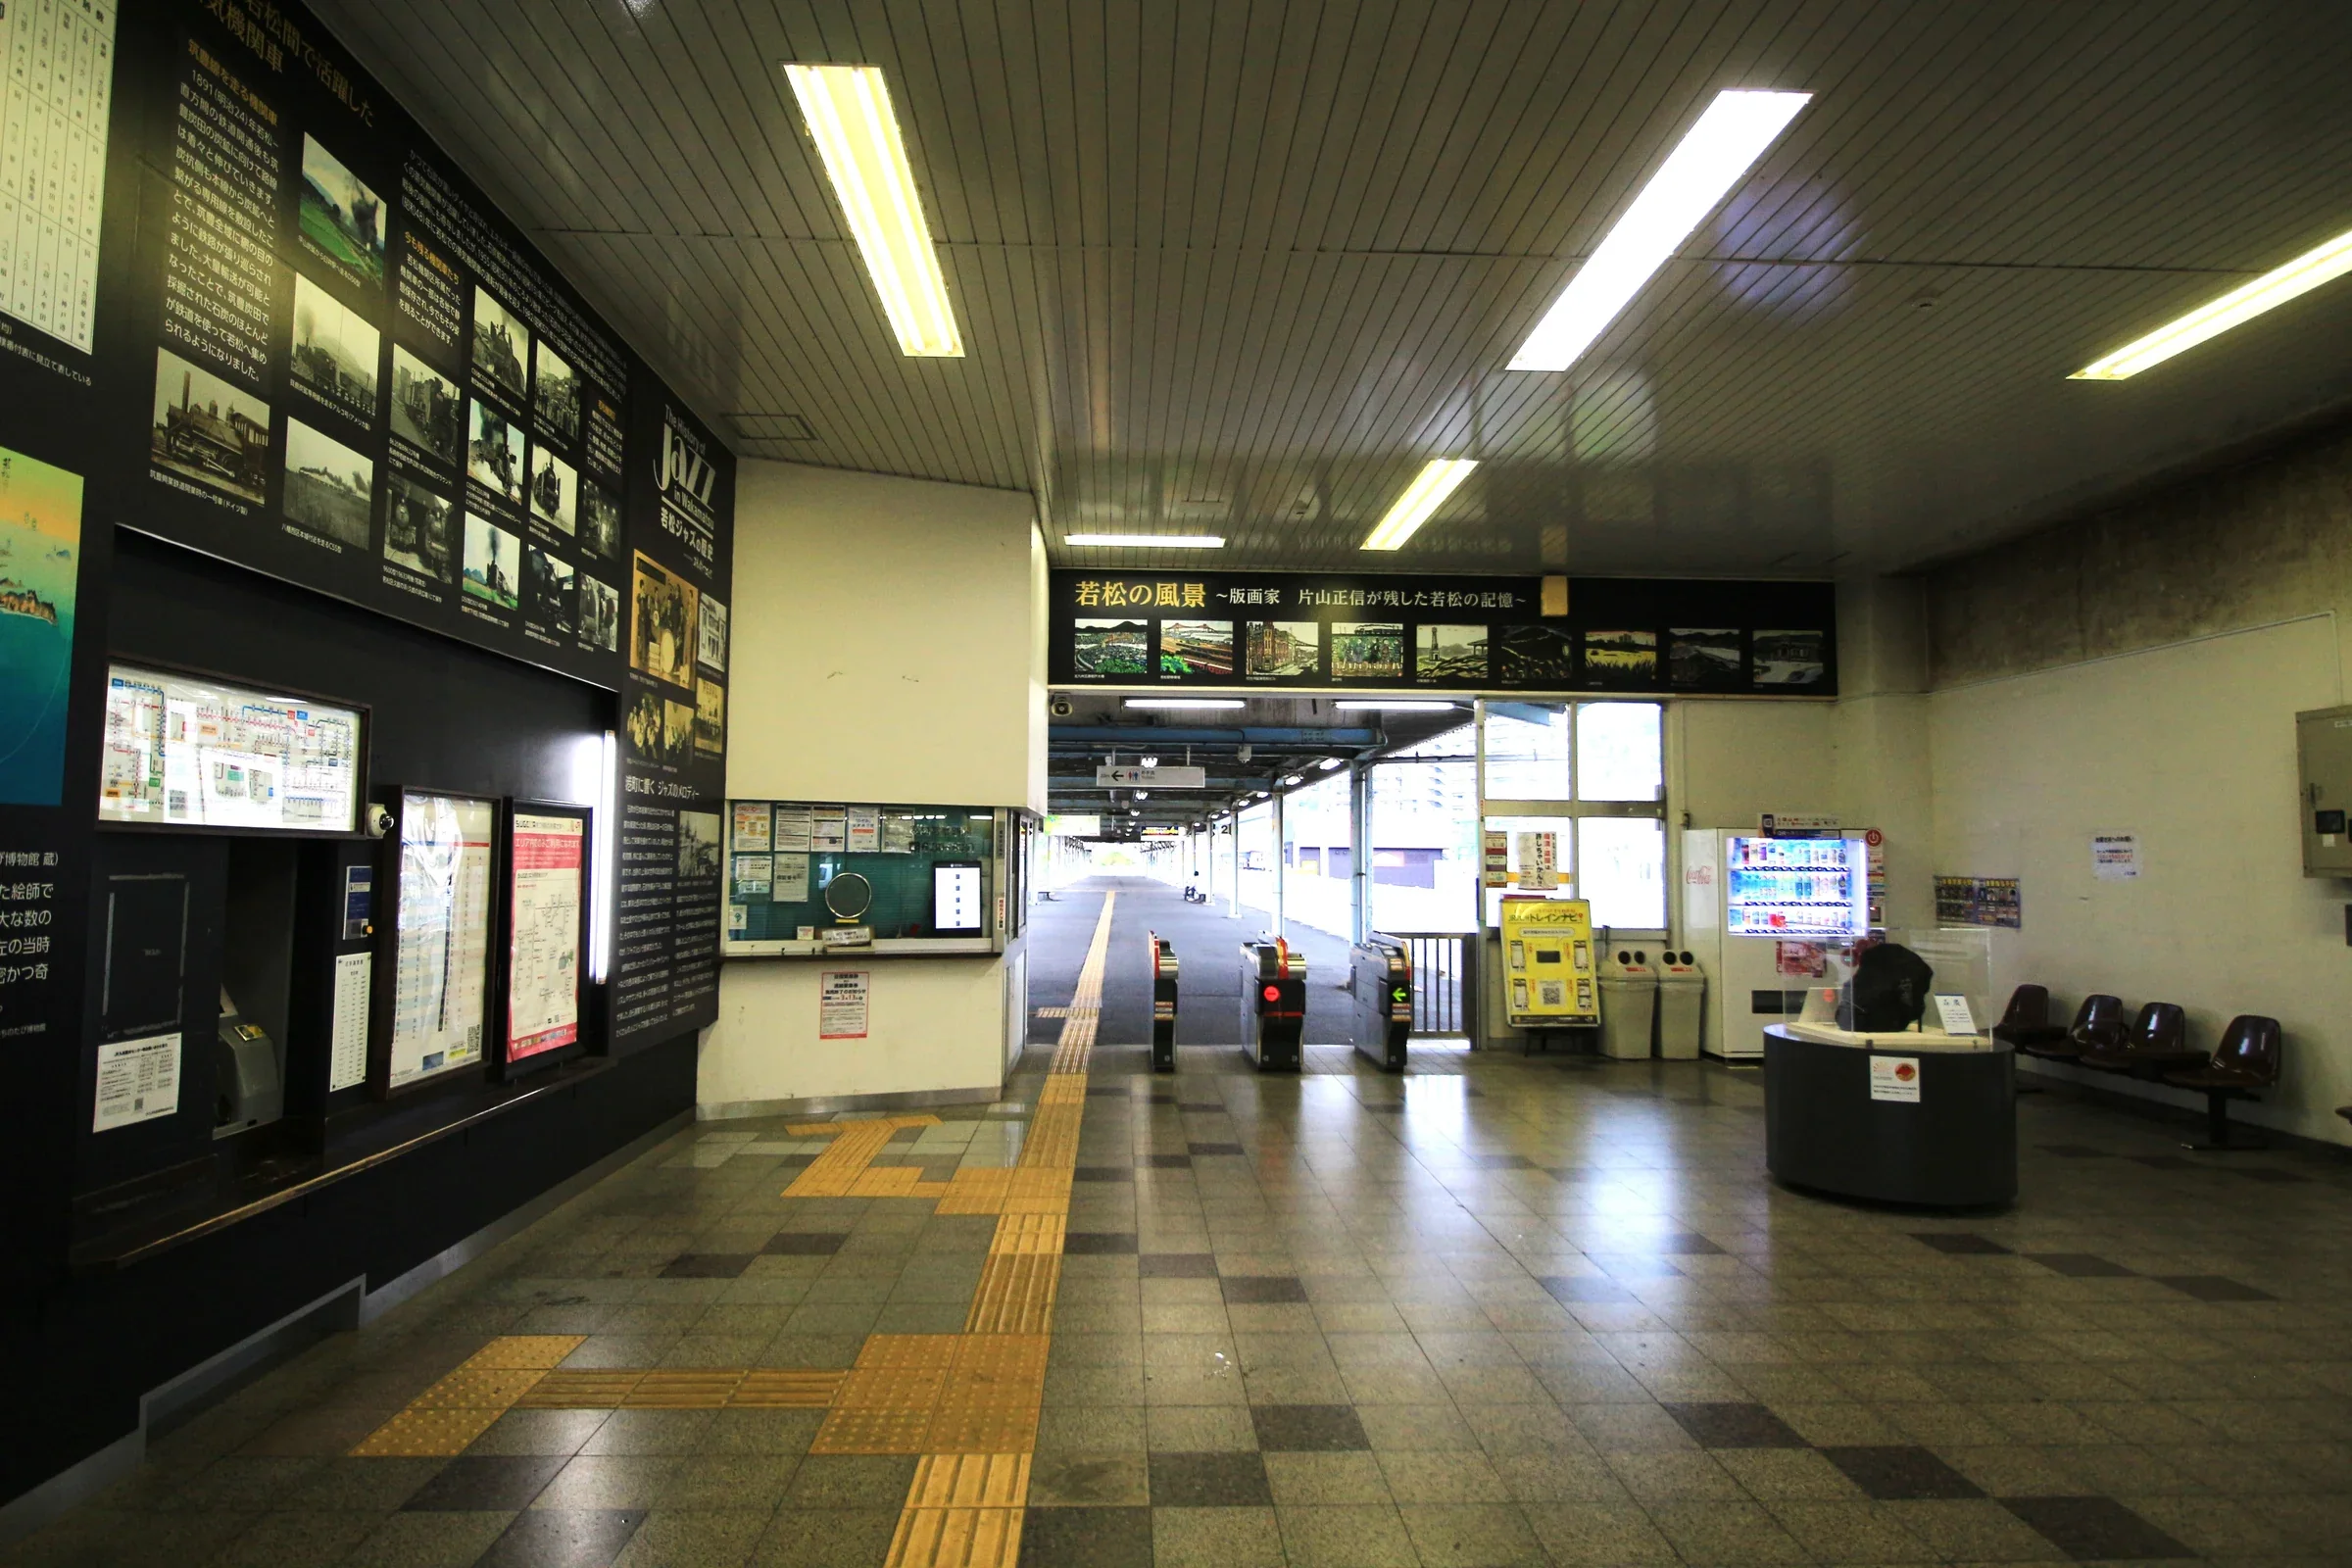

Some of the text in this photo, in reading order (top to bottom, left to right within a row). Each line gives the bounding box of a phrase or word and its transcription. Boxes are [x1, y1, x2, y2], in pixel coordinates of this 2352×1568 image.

[1075, 581, 1206, 609] 若松の風景
[1220, 824, 1229, 834] 2
